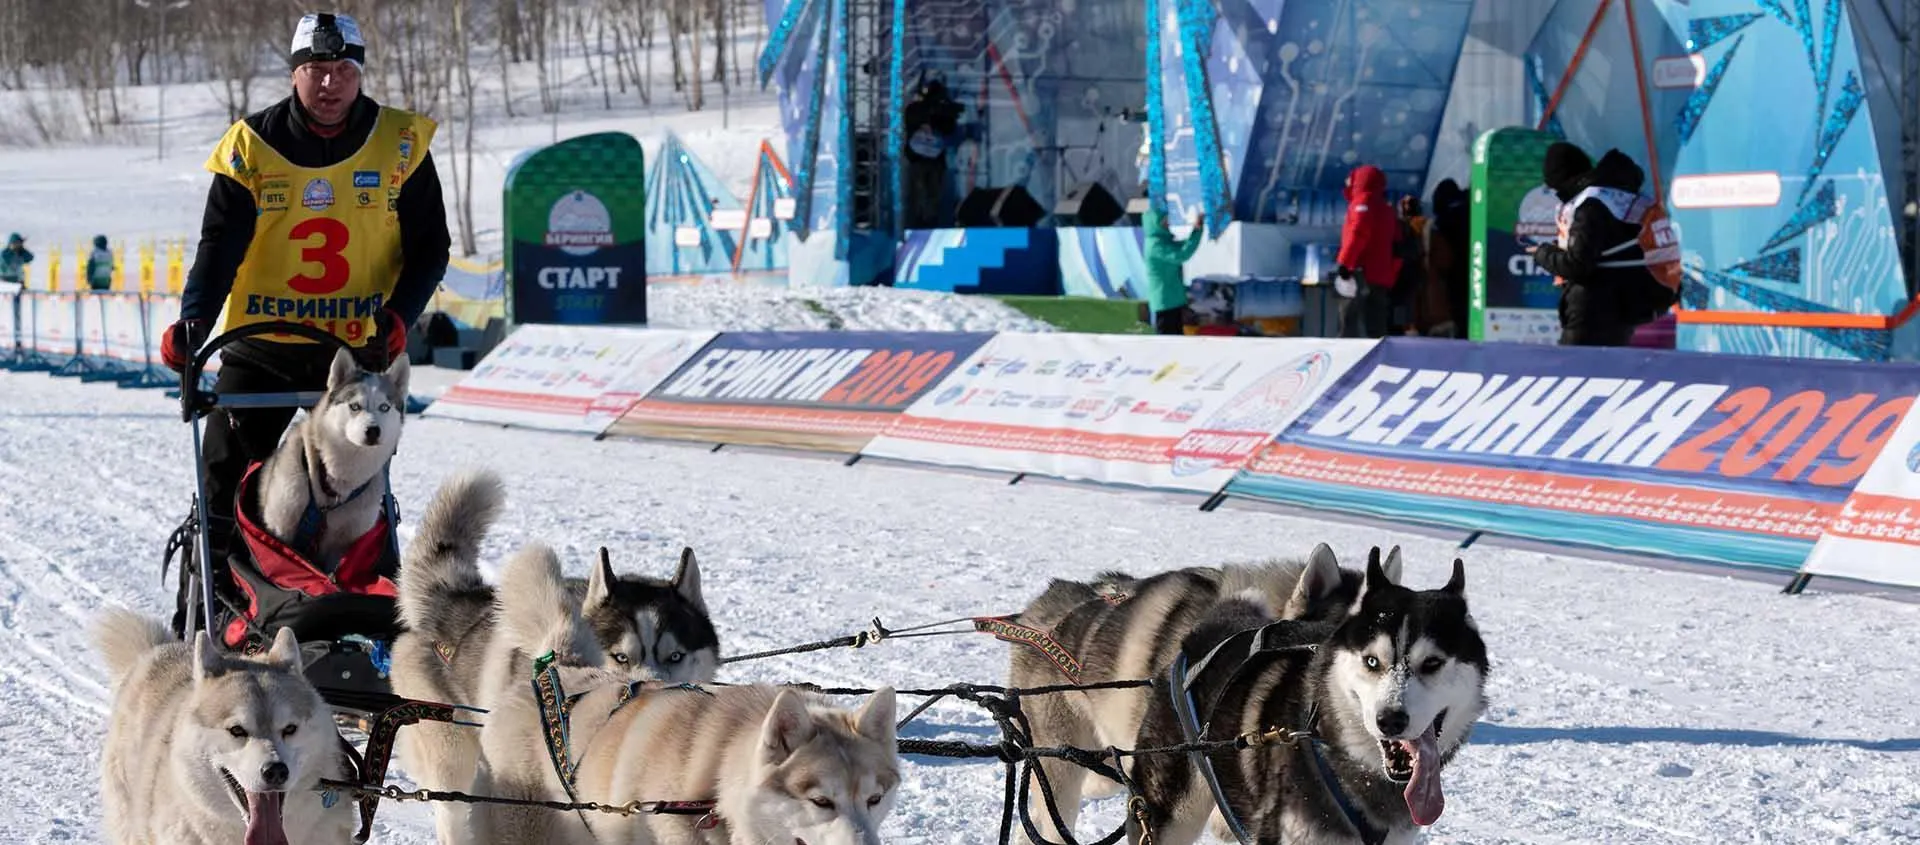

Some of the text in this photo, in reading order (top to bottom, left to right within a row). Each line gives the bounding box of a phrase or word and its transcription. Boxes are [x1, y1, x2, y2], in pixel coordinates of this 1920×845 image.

[267, 192, 286, 203] ВТБ
[545, 232, 614, 245] БЕРИНГИЯ
[288, 217, 350, 294] 3
[1508, 254, 1552, 276] СТА
[537, 266, 622, 289] СТАРТ
[246, 293, 383, 318] БЕРИНГИЯ
[664, 349, 873, 400] БЕРИНГИЯ
[820, 349, 954, 404] 2019
[1310, 364, 1916, 485] БЕРИНГИЯ 2019
